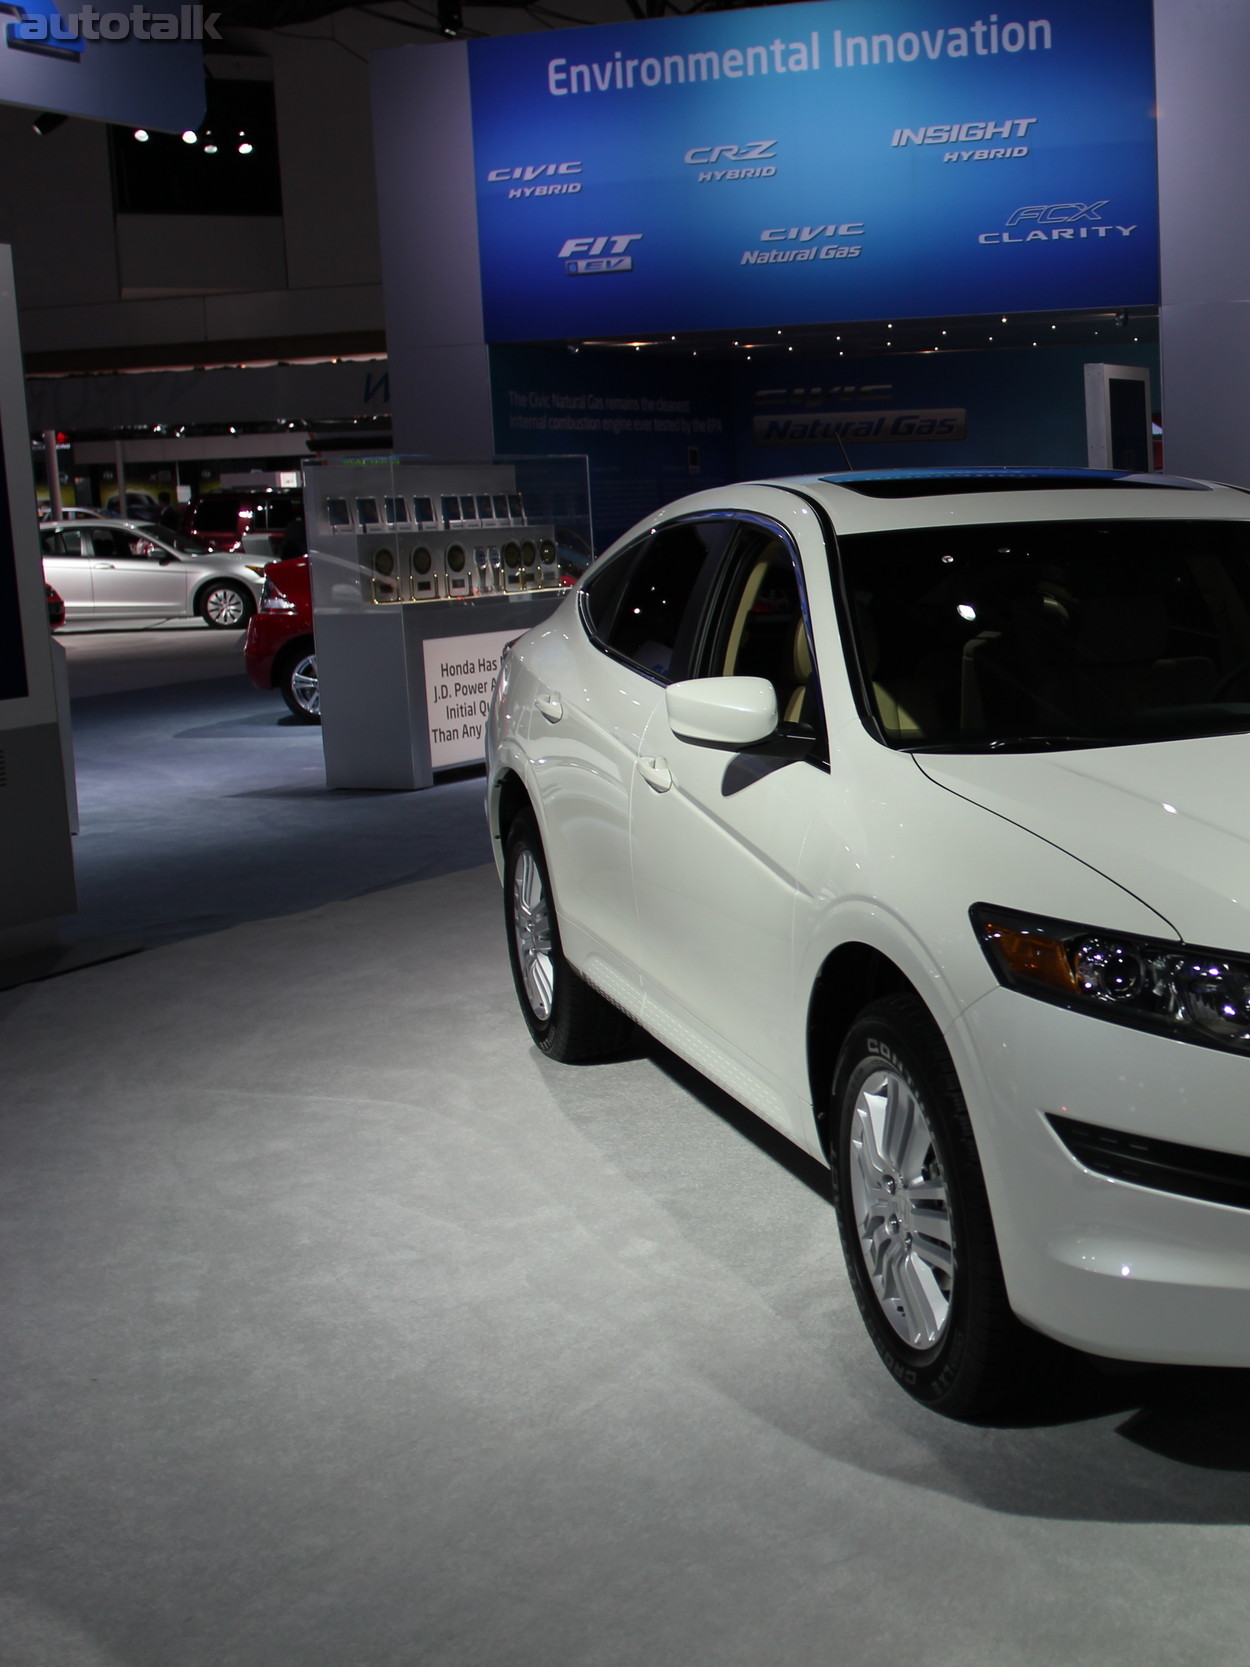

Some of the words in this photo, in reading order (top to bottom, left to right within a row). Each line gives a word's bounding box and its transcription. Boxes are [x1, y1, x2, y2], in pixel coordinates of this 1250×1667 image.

[547, 31, 820, 95] Environmental
[833, 14, 1053, 68] Innovation
[891, 117, 1037, 147] INSIGHT
[684, 139, 778, 164] CR-Z
[943, 146, 1029, 163] HYBRID
[487, 161, 583, 183] CIVIC
[698, 166, 777, 183] HYBRID
[508, 182, 582, 199] HYBRID
[1005, 200, 1111, 226] FCX
[760, 222, 865, 242] CIVIC
[978, 225, 1139, 245] CLARITY
[557, 233, 643, 259] FIT
[740, 246, 818, 265] Natural
[819, 244, 863, 260] Gas
[584, 258, 625, 272] EV
[507, 391, 528, 408] The
[552, 393, 587, 410] Natural
[587, 394, 604, 411] Gas
[605, 396, 639, 412] remains
[548, 415, 601, 431] combustion
[603, 416, 632, 435] engine
[764, 416, 886, 441] Natural
[890, 415, 958, 436] Gas
[440, 660, 475, 678] Honda
[477, 658, 498, 673] Has
[434, 685, 452, 704] J.D.
[454, 681, 488, 697] Power
[446, 701, 477, 720] Initial
[431, 728, 459, 744] Than
[462, 723, 482, 740] Any
